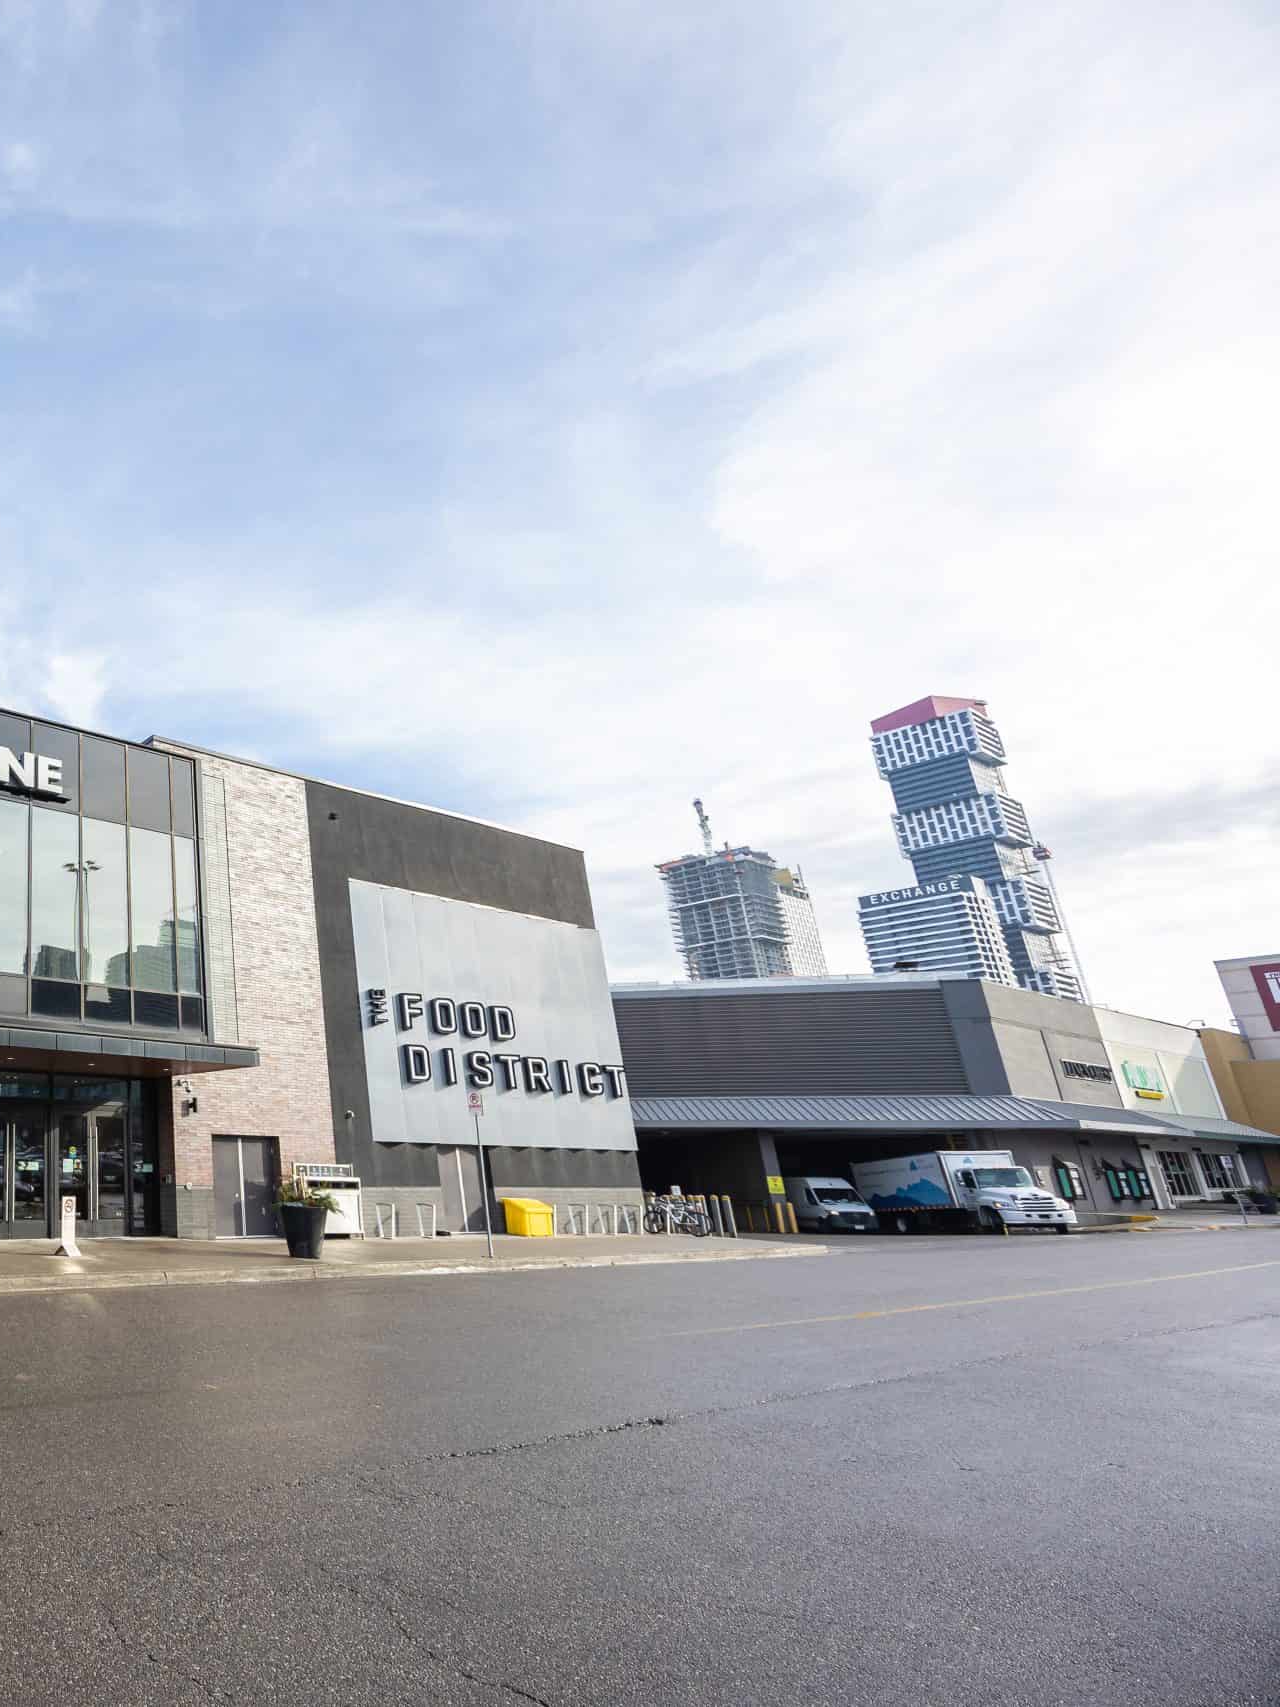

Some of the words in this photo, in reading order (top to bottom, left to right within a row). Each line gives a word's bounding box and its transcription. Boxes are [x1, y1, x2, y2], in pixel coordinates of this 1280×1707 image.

[869, 879, 961, 905] EXCHANGE
[369, 988, 389, 1025] THE
[399, 993, 516, 1042] FOOD
[405, 1044, 625, 1099] DISTRICT
